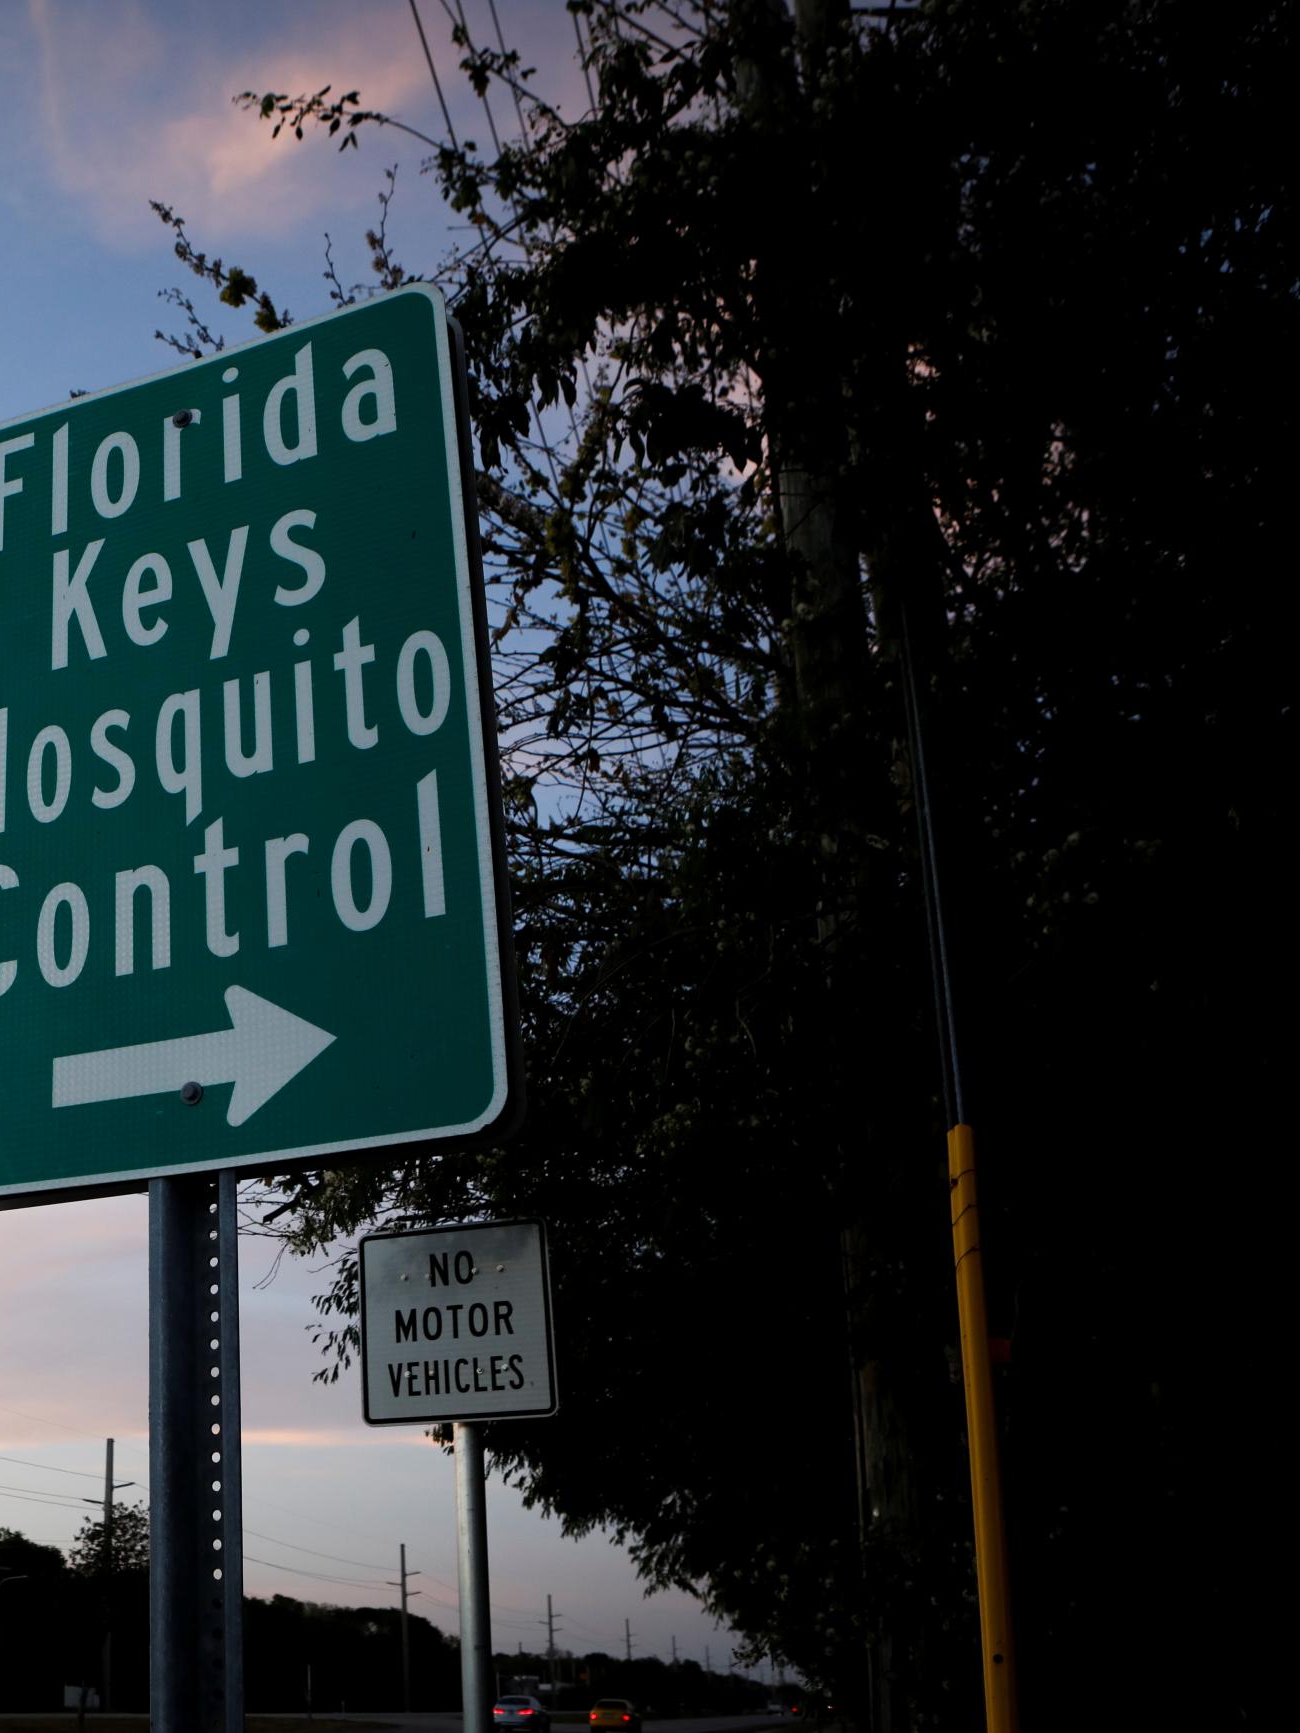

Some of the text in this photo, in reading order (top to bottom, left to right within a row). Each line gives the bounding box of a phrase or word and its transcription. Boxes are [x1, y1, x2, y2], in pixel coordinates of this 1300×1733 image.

[51, 508, 326, 671] Keys
[429, 1250, 475, 1287] NO
[394, 1300, 515, 1343] MOTOR
[387, 1354, 525, 1398] VEHICLES
